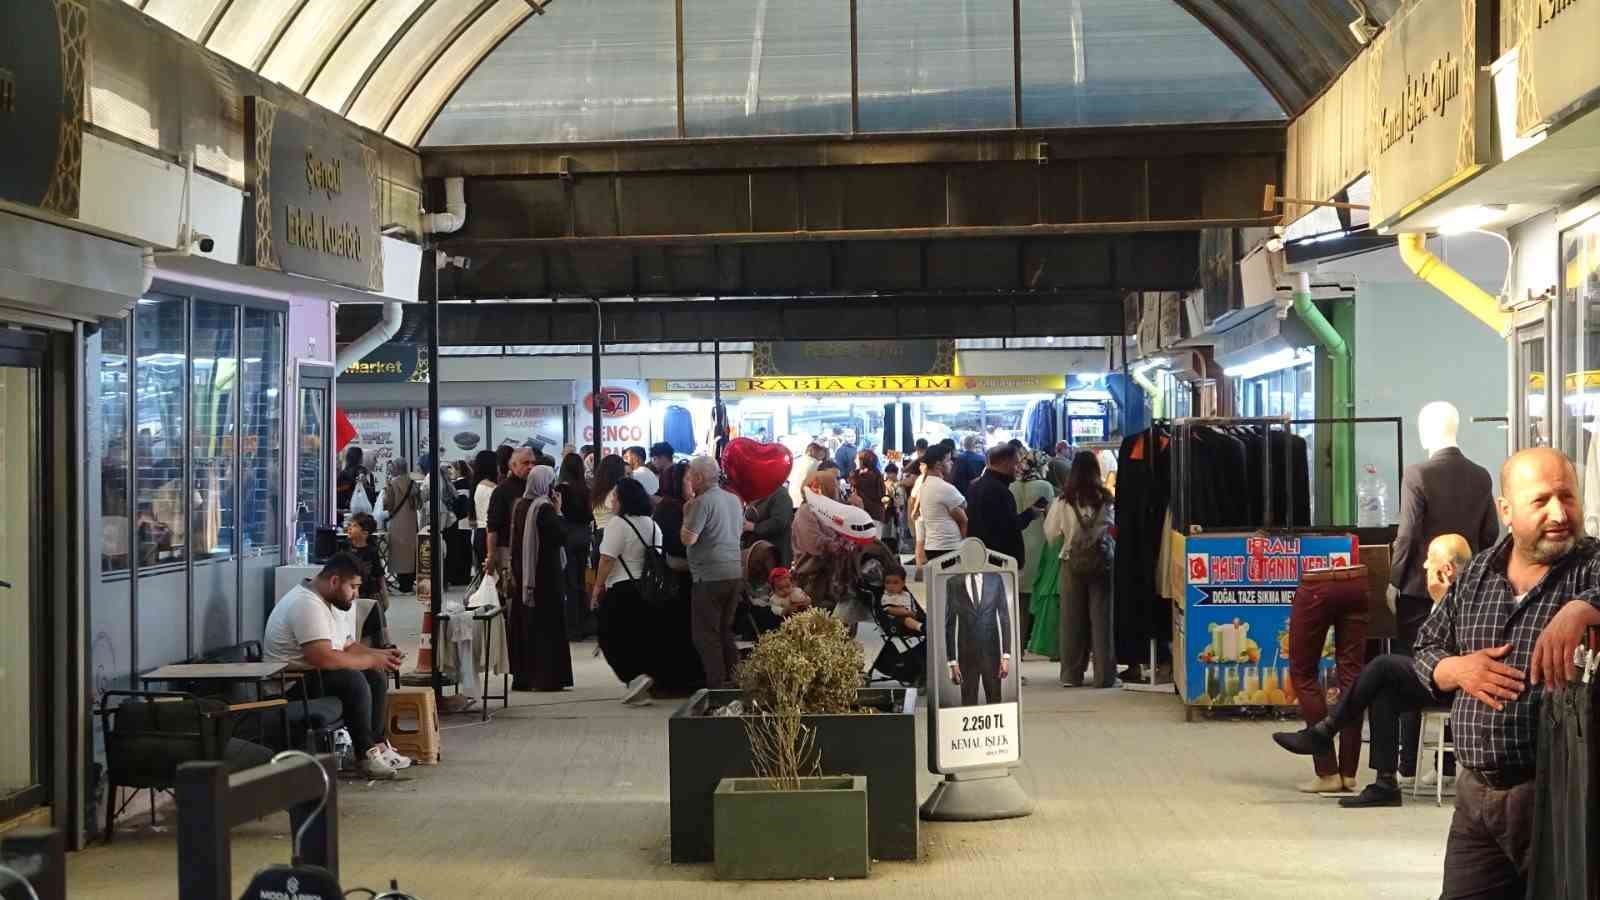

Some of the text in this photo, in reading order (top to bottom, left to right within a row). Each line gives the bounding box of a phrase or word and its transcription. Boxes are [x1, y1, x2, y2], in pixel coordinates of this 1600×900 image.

[856, 376, 952, 389] GİYİM
[1248, 556, 1298, 583] UTANIN
[1238, 590, 1256, 604] TAZE
[962, 713, 1003, 731] 2.250 TL
[951, 737, 982, 751] KEMAL
